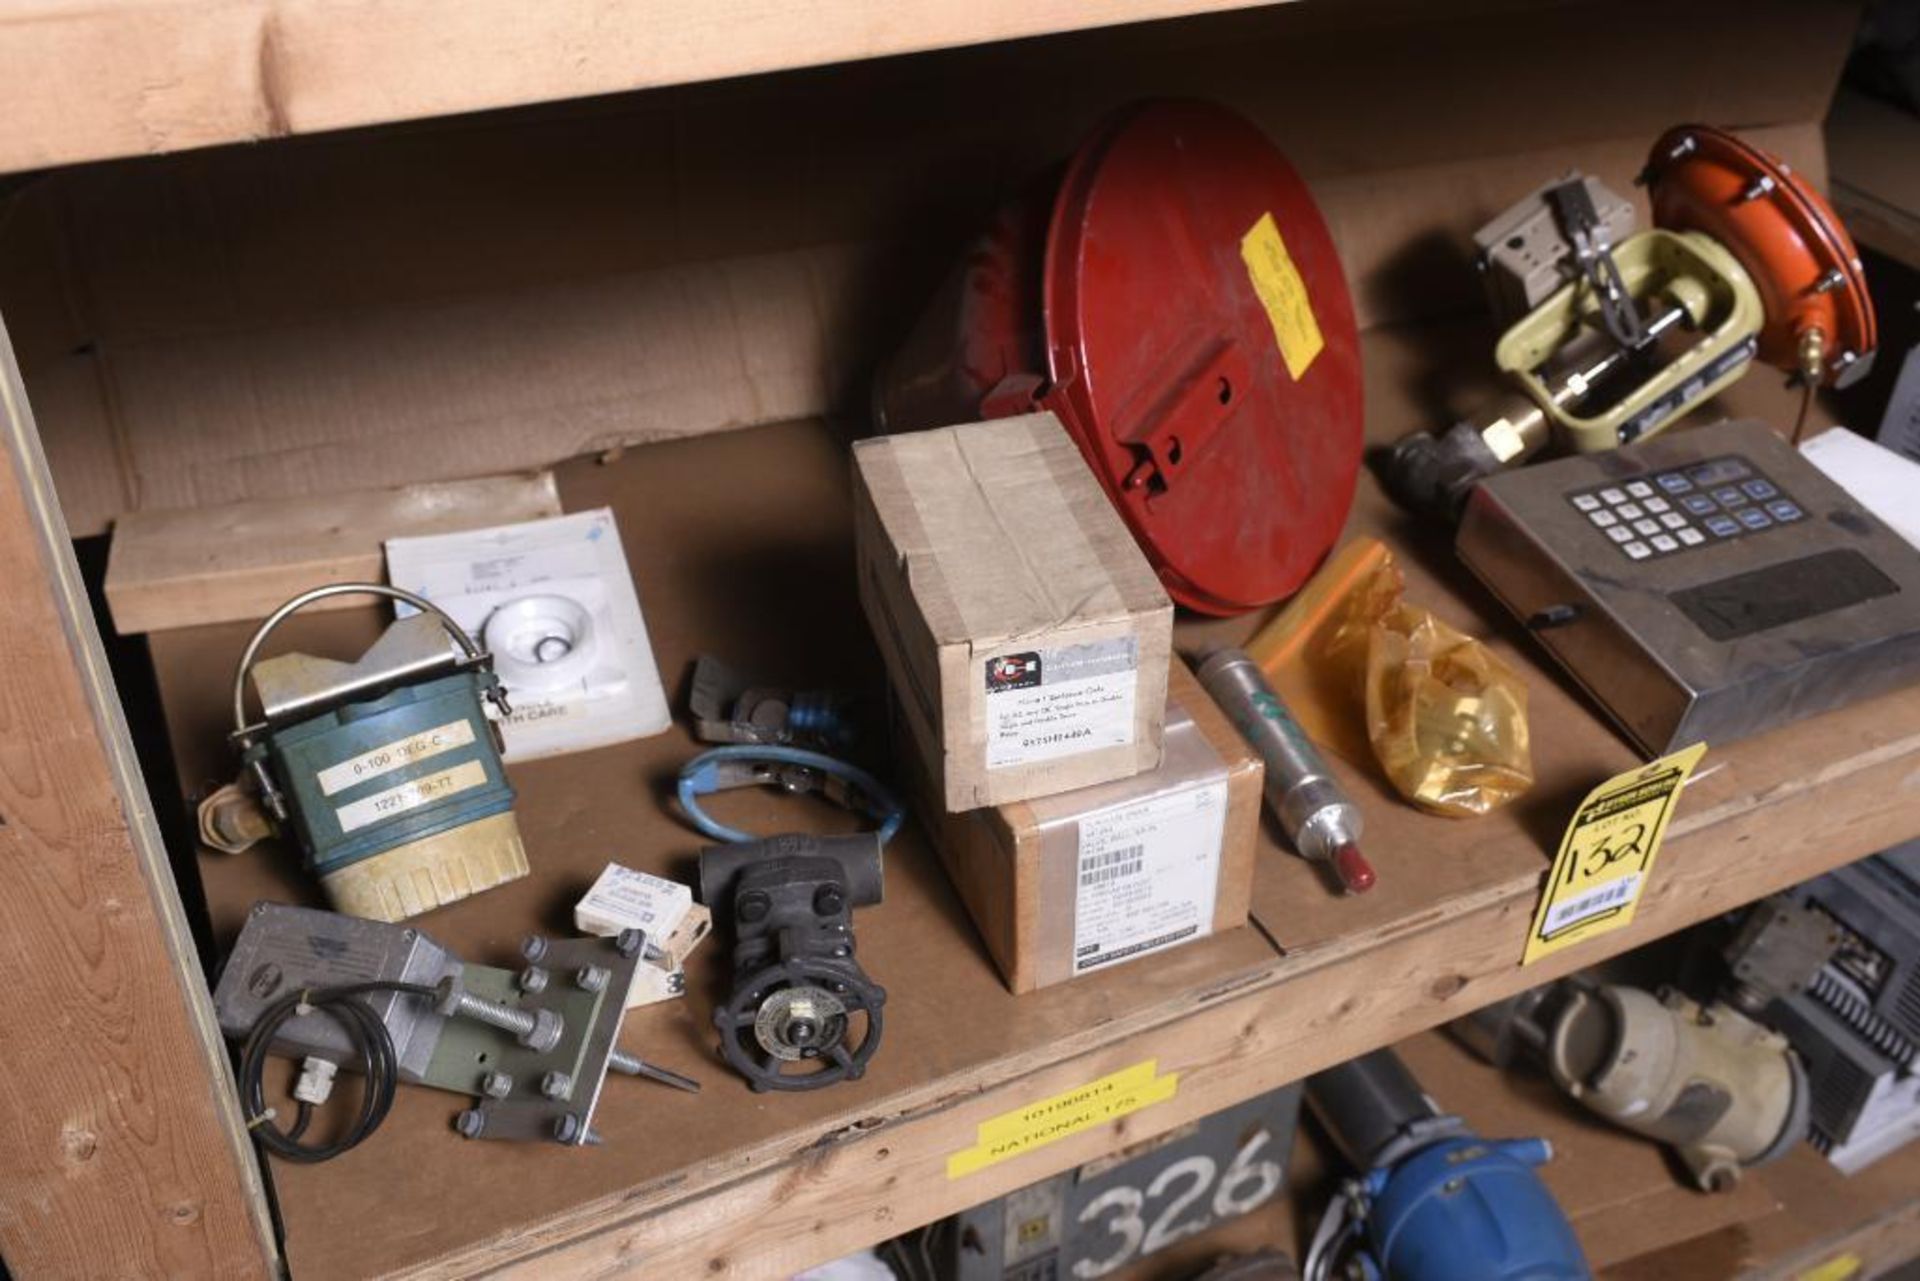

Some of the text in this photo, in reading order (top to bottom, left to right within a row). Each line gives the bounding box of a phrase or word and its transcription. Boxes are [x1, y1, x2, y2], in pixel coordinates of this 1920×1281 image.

[353, 754, 391, 775] 0-100
[1567, 823, 1645, 884] 132
[990, 1111, 1092, 1156] NATIONAL
[1072, 1129, 1281, 1279] 326
